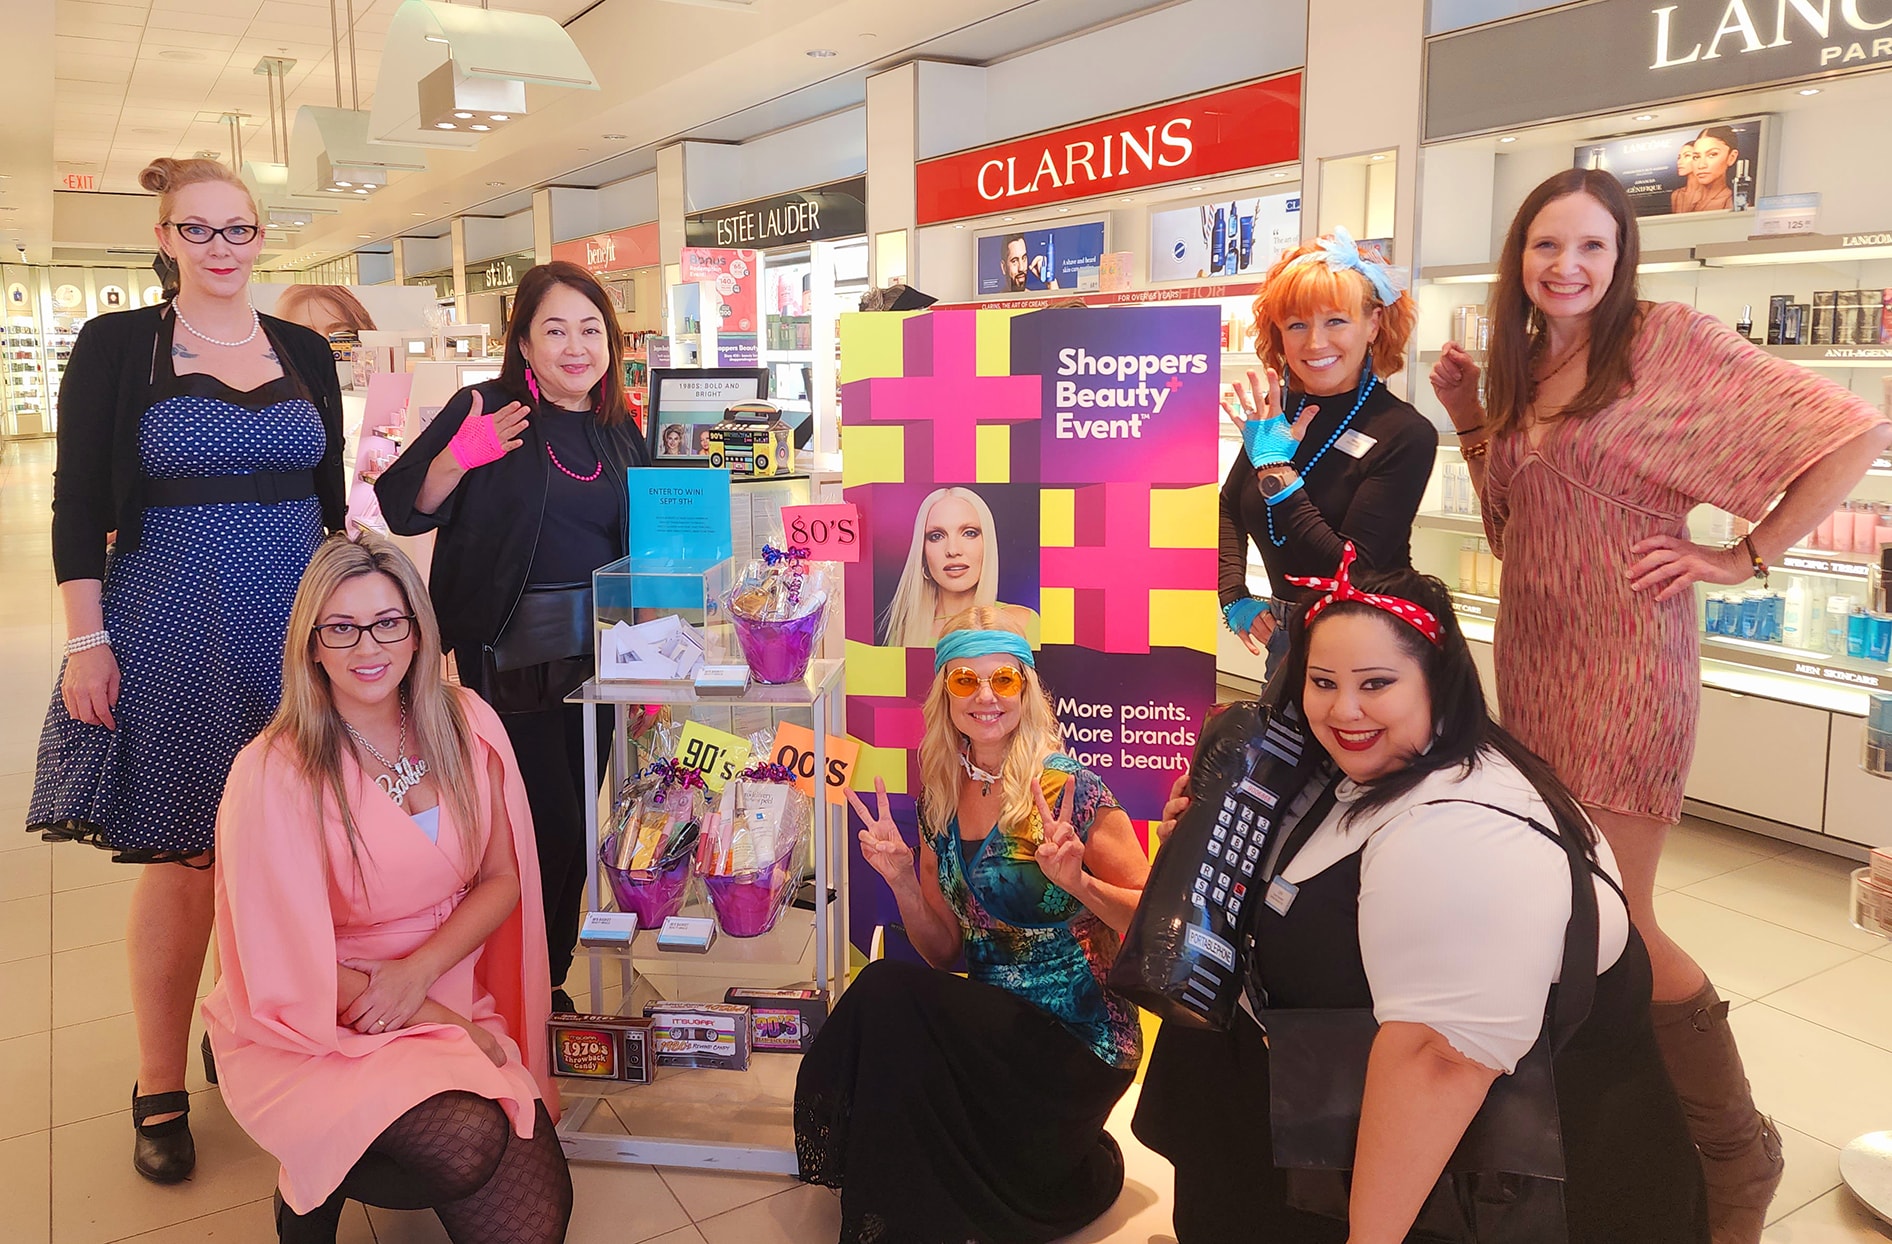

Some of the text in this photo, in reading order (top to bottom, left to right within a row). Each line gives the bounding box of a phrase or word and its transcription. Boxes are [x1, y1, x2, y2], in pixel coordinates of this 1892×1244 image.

[977, 118, 1193, 200] CLARINS
[68, 174, 94, 190] EXIT
[758, 200, 820, 238] LAUDER
[586, 237, 616, 269] benefit
[689, 254, 726, 266] Bonus
[486, 262, 514, 287] stila
[1117, 294, 1131, 302] FOR
[1131, 293, 1147, 301] OVER
[1157, 290, 1179, 299] YEARS
[1057, 348, 1208, 381] Shoppers
[1795, 664, 1879, 686] MEN SKINCARE
[1056, 698, 1191, 723] More points.
[1059, 722, 1113, 743] More
[563, 1041, 609, 1057] 1970's
[563, 1053, 607, 1063] Throwback
[573, 1062, 598, 1070] Candy
